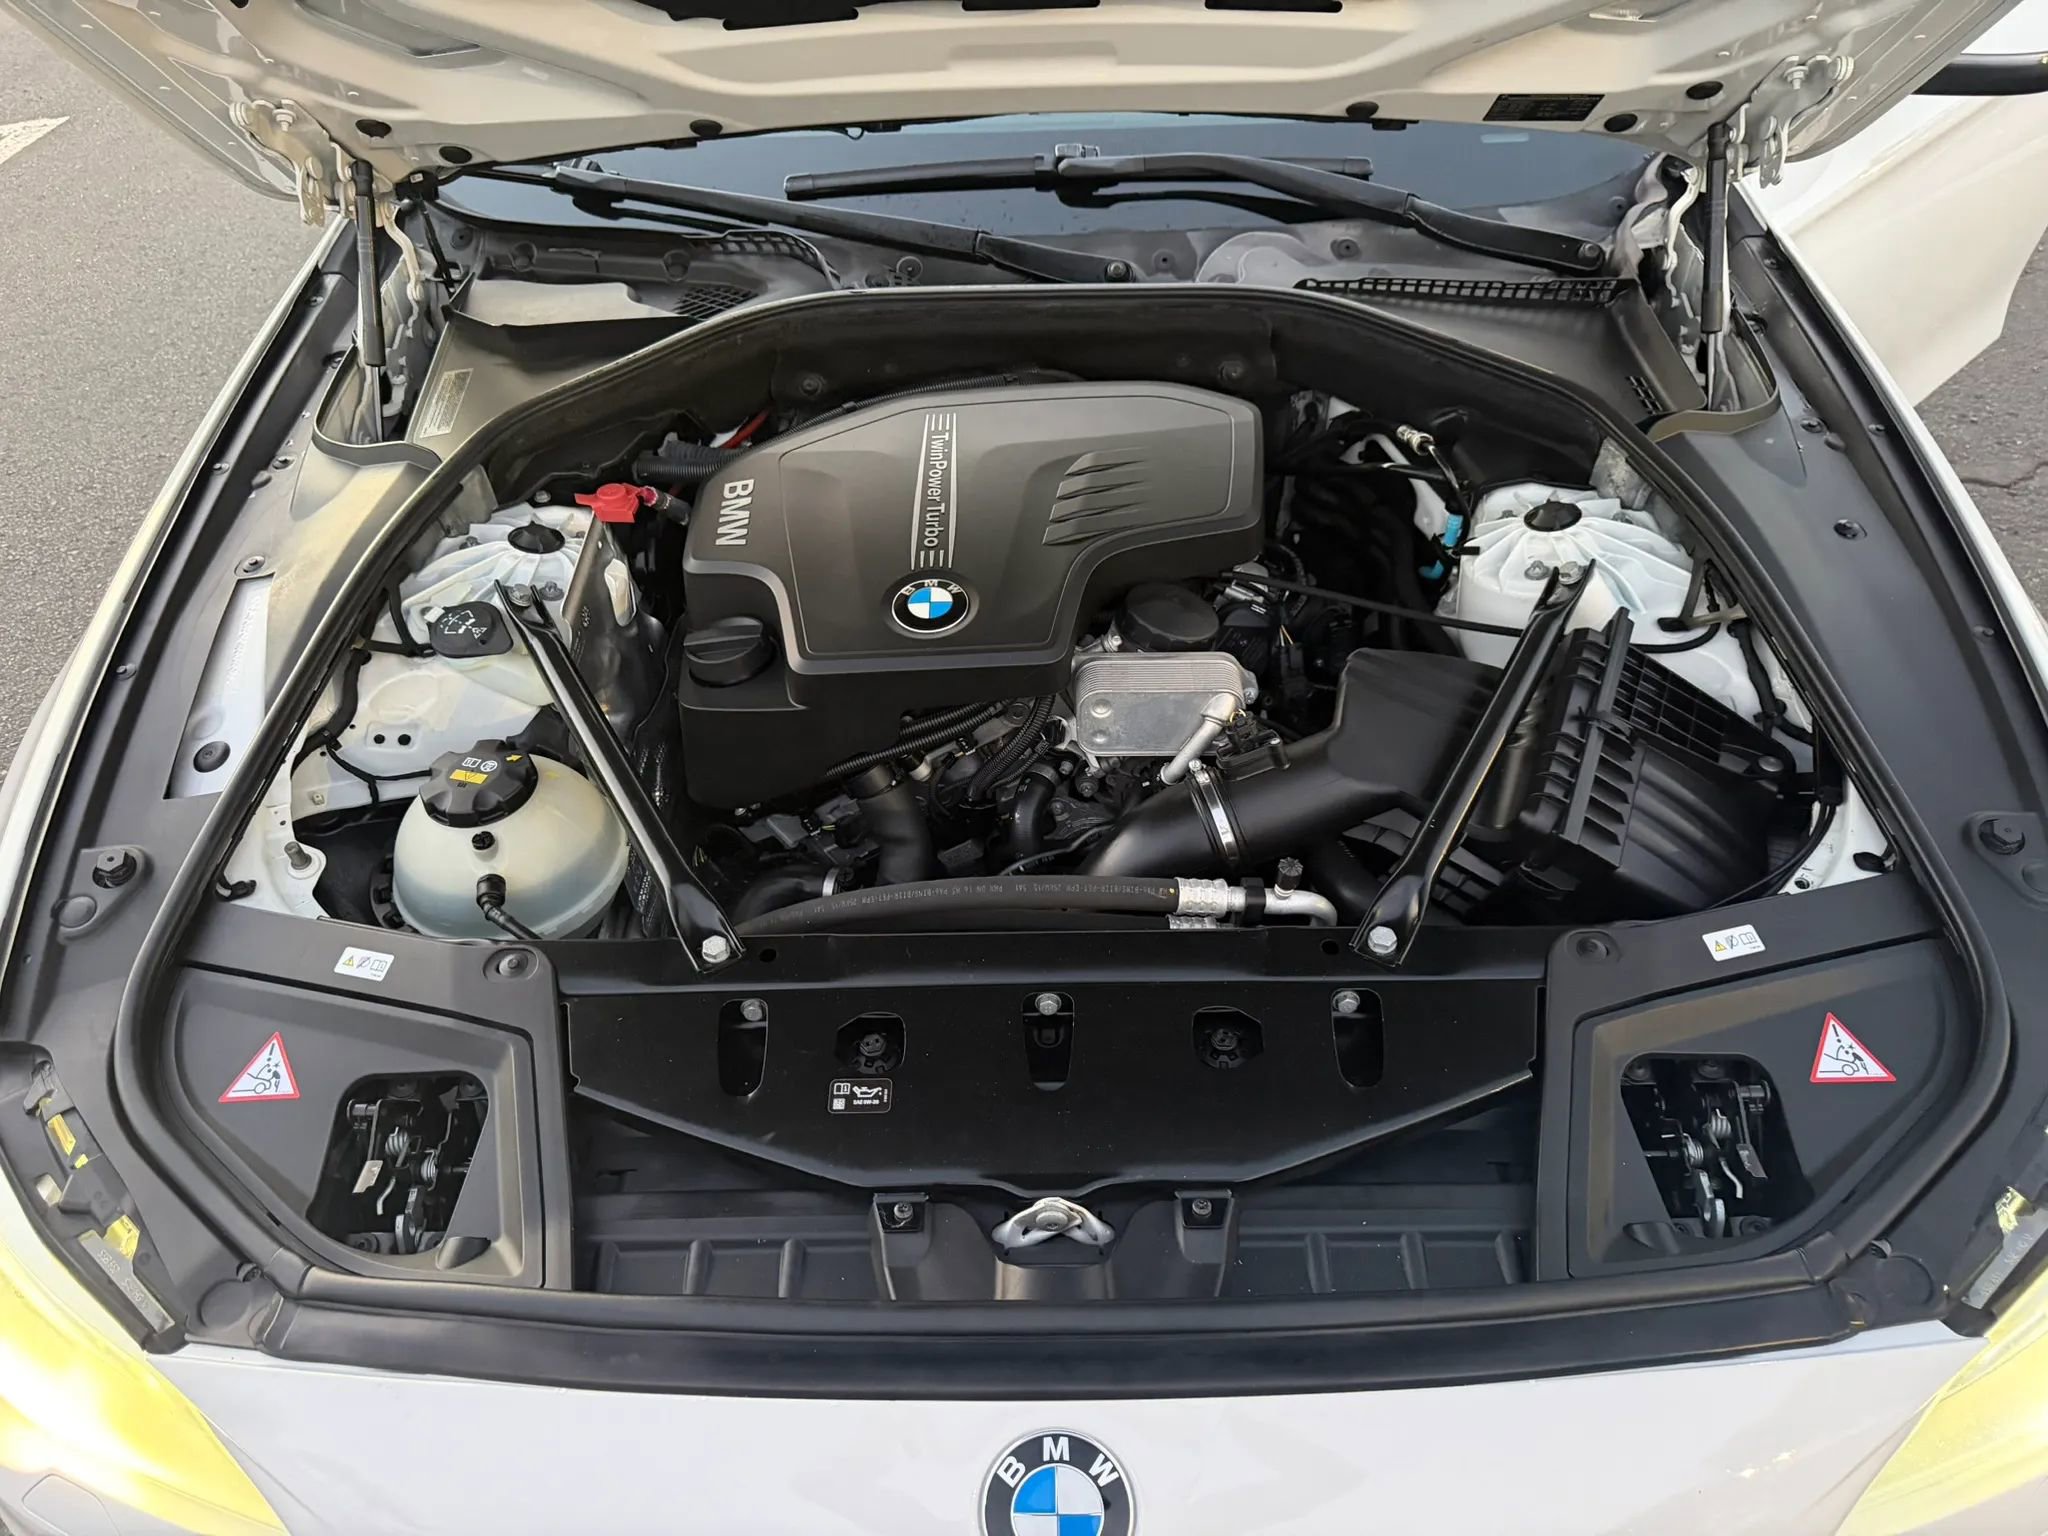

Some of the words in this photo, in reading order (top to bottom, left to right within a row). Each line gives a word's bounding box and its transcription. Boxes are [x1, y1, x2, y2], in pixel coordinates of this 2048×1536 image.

[927, 432, 949, 502] TwinPower
[715, 478, 755, 546] BMW
[923, 503, 945, 547] Turbo
[901, 580, 962, 596] BMW
[997, 1436, 1120, 1488] BMW
